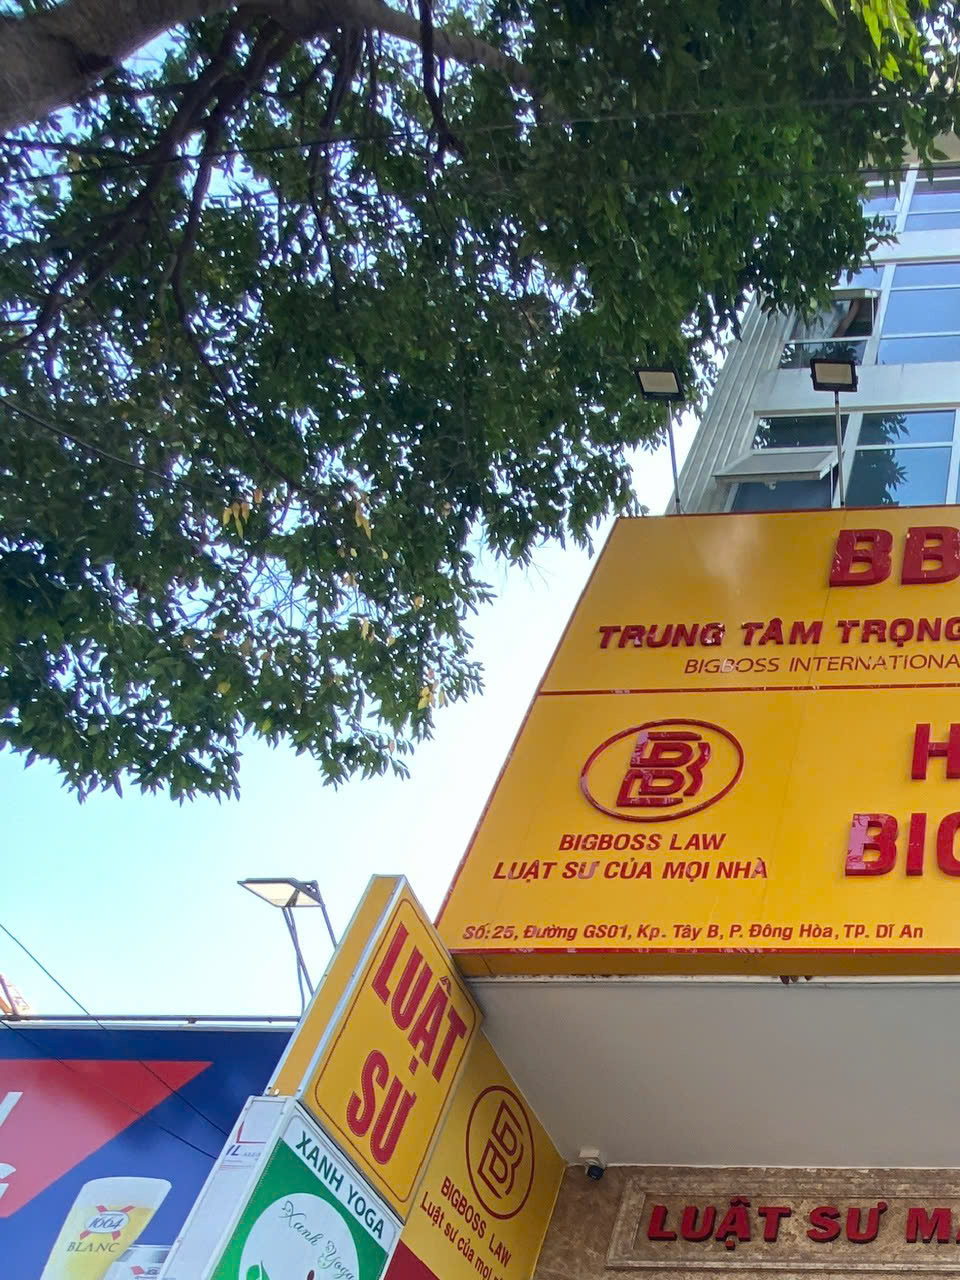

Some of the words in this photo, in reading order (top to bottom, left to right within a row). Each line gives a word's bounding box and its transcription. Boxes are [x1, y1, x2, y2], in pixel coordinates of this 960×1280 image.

[599, 623, 726, 649] TRUNG
[741, 617, 823, 646] TÂM
[684, 657, 780, 675] BIGBOSS
[492, 859, 557, 883] LUẬT
[562, 860, 600, 879] SƯ
[603, 857, 652, 879] CỦA
[661, 861, 709, 882] MỌI
[715, 857, 768, 879] NHÀ
[558, 833, 662, 851] BIGBOSS
[669, 833, 727, 851] LAW
[523, 925, 578, 941] Đường
[583, 924, 632, 941] GS01,
[673, 923, 702, 941] Tây
[706, 924, 724, 940] B,
[729, 924, 744, 938] P.
[749, 923, 793, 941] Đông
[799, 923, 840, 940] Hòa,
[843, 924, 870, 938] TP.
[899, 924, 924, 938] An
[371, 921, 467, 1084] LUẬT
[346, 1049, 417, 1165] SƯ
[296, 1130, 344, 1192] XANH
[347, 1184, 384, 1239] YOGA
[66, 1242, 121, 1253] BLANC
[279, 1200, 324, 1246] Xanh
[318, 1240, 354, 1280] Yoga
[420, 1192, 444, 1229] Luật
[444, 1222, 457, 1243] sư
[457, 1237, 475, 1264] của
[440, 1176, 487, 1239] BIGBOSS
[488, 1233, 512, 1268] LAW
[647, 1195, 792, 1251] LUẬT
[806, 1201, 888, 1244] SƯ
